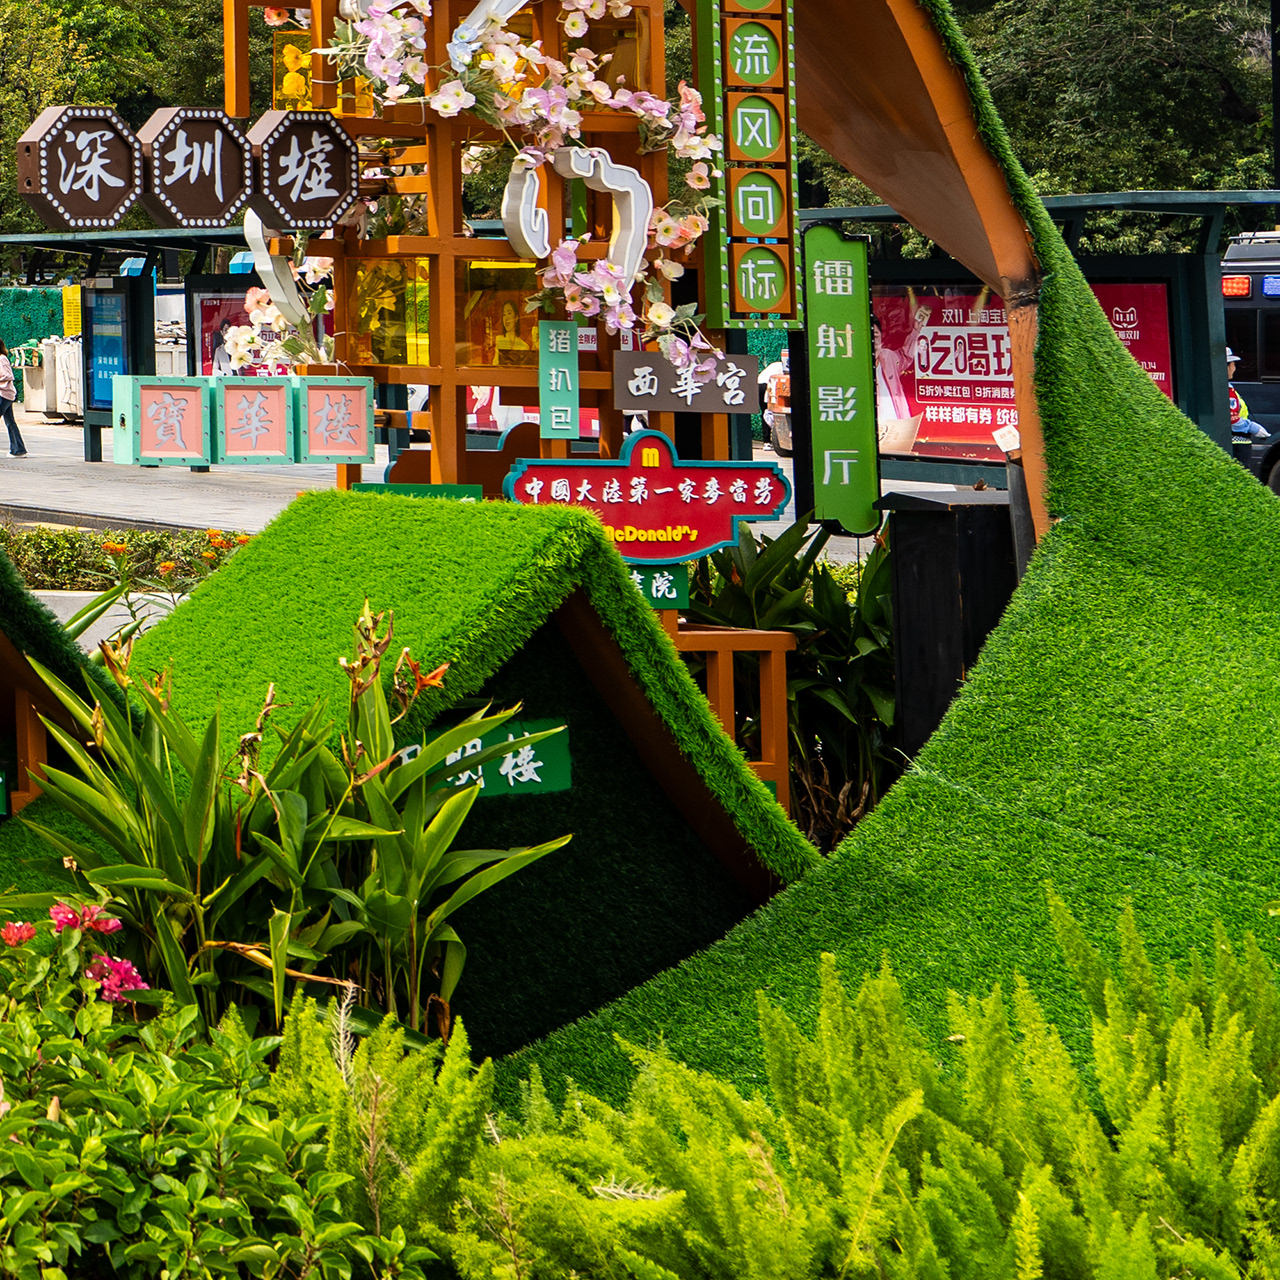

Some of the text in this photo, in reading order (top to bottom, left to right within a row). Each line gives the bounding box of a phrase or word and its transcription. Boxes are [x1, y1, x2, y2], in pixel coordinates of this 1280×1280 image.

[57, 129, 340, 203] 深圳墟
[941, 309, 963, 324] 双11
[1115, 314, 1134, 322] 11.11
[548, 329, 573, 430] 猪扒包
[814, 260, 859, 485] 镭射影厅
[919, 385, 971, 398] 5折外卖红包
[925, 406, 993, 425] 样样都有券
[604, 524, 698, 542] McDonald's
